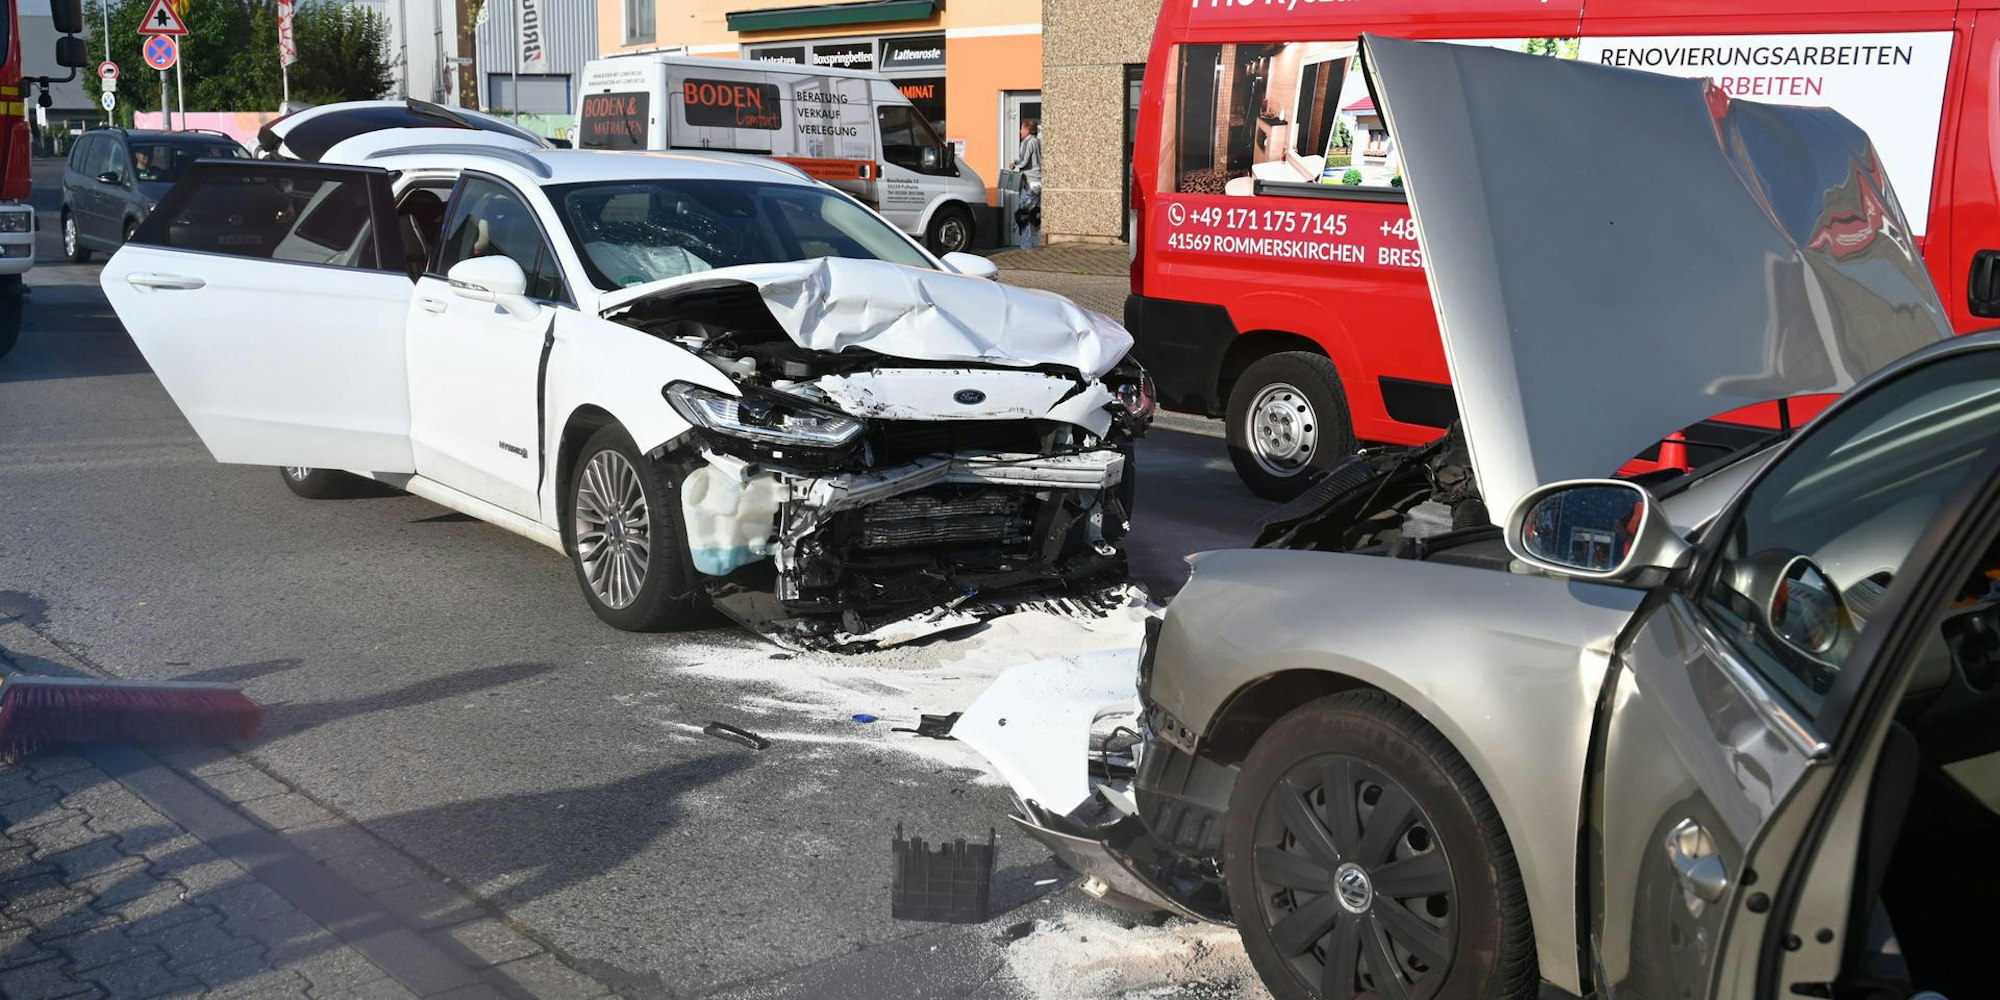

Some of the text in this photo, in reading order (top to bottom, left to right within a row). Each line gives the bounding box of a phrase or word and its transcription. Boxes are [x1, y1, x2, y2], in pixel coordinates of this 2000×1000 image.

[813, 51, 873, 67] Boxspringbetten
[893, 48, 941, 61] Lattenroste
[1600, 45, 1913, 66] RENOVIERUNGSARBEITEN
[684, 82, 764, 109] BODEN
[1711, 77, 1823, 96] RBEITEN
[585, 96, 638, 118] BODEN &
[796, 91, 848, 104] BERATUNG
[798, 108, 841, 119] VERKAUF
[799, 125, 857, 136] VERLEGUNG
[1190, 207, 1347, 236] +49 171 175 7145
[1379, 218, 1417, 241] +48
[1168, 233, 1365, 263] 41569 ROMMERSKIRCHEN
